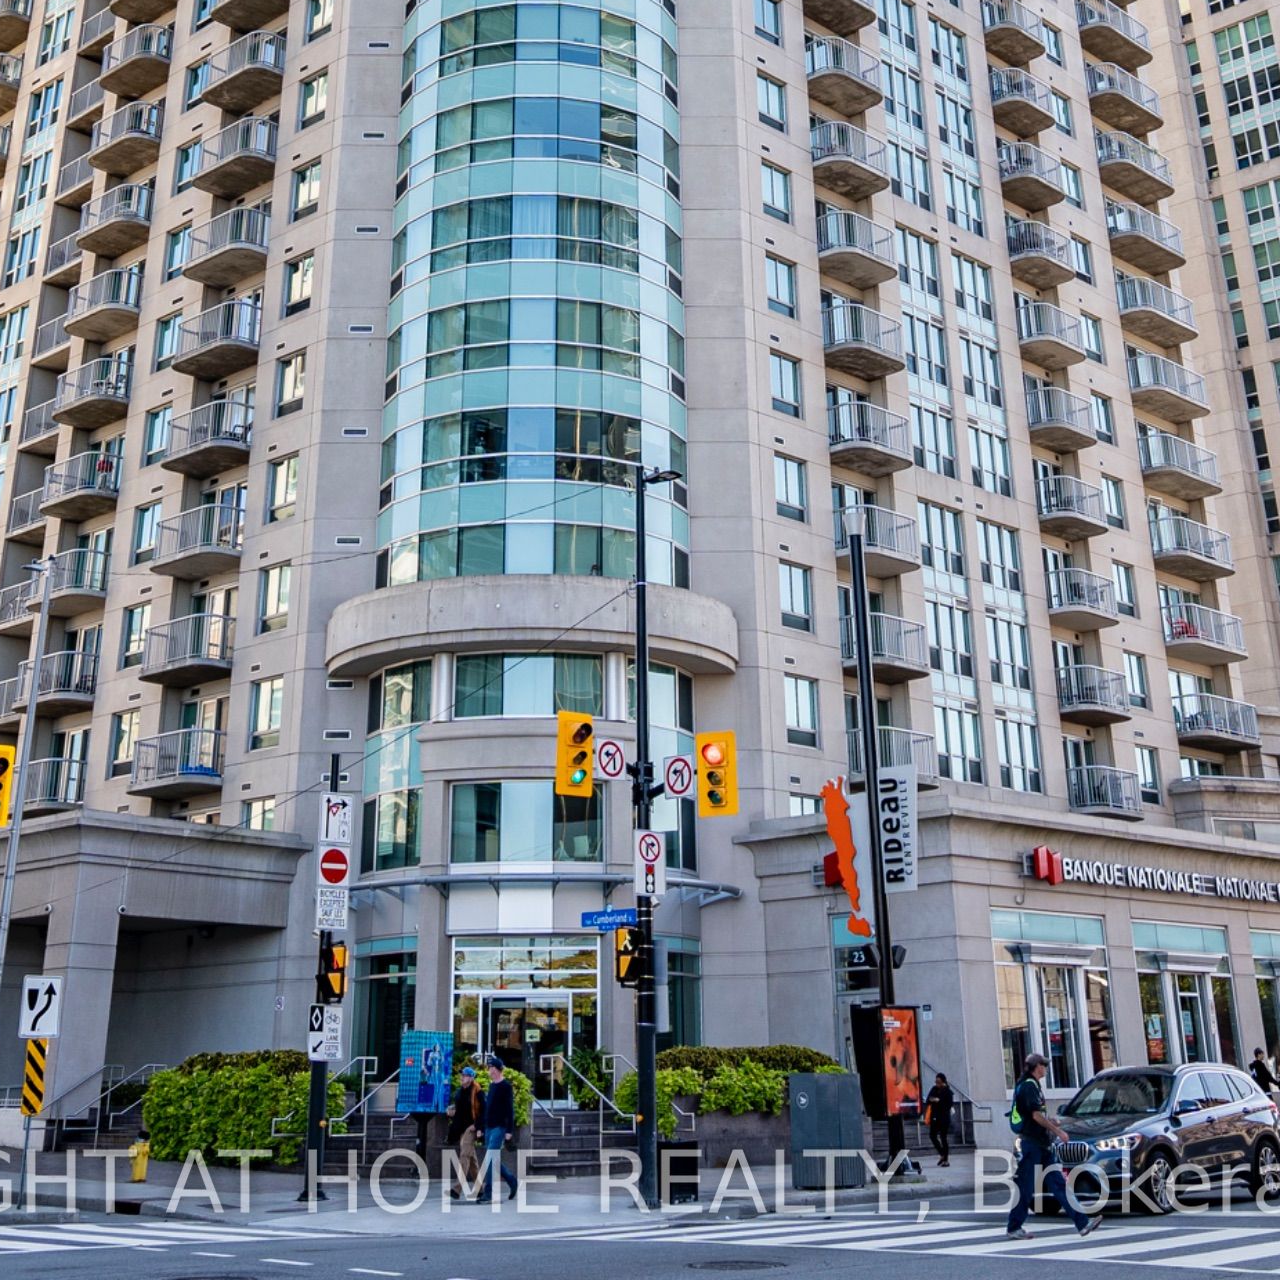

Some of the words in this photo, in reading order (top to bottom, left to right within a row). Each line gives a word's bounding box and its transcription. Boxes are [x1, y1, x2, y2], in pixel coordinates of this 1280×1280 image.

[899, 778, 913, 876] CENTRE-VILLE
[1062, 857, 1124, 886] BANQUE
[1127, 865, 1201, 894] NATIONALE
[320, 889, 346, 899] BICYCLES
[593, 913, 627, 924] Cumberland
